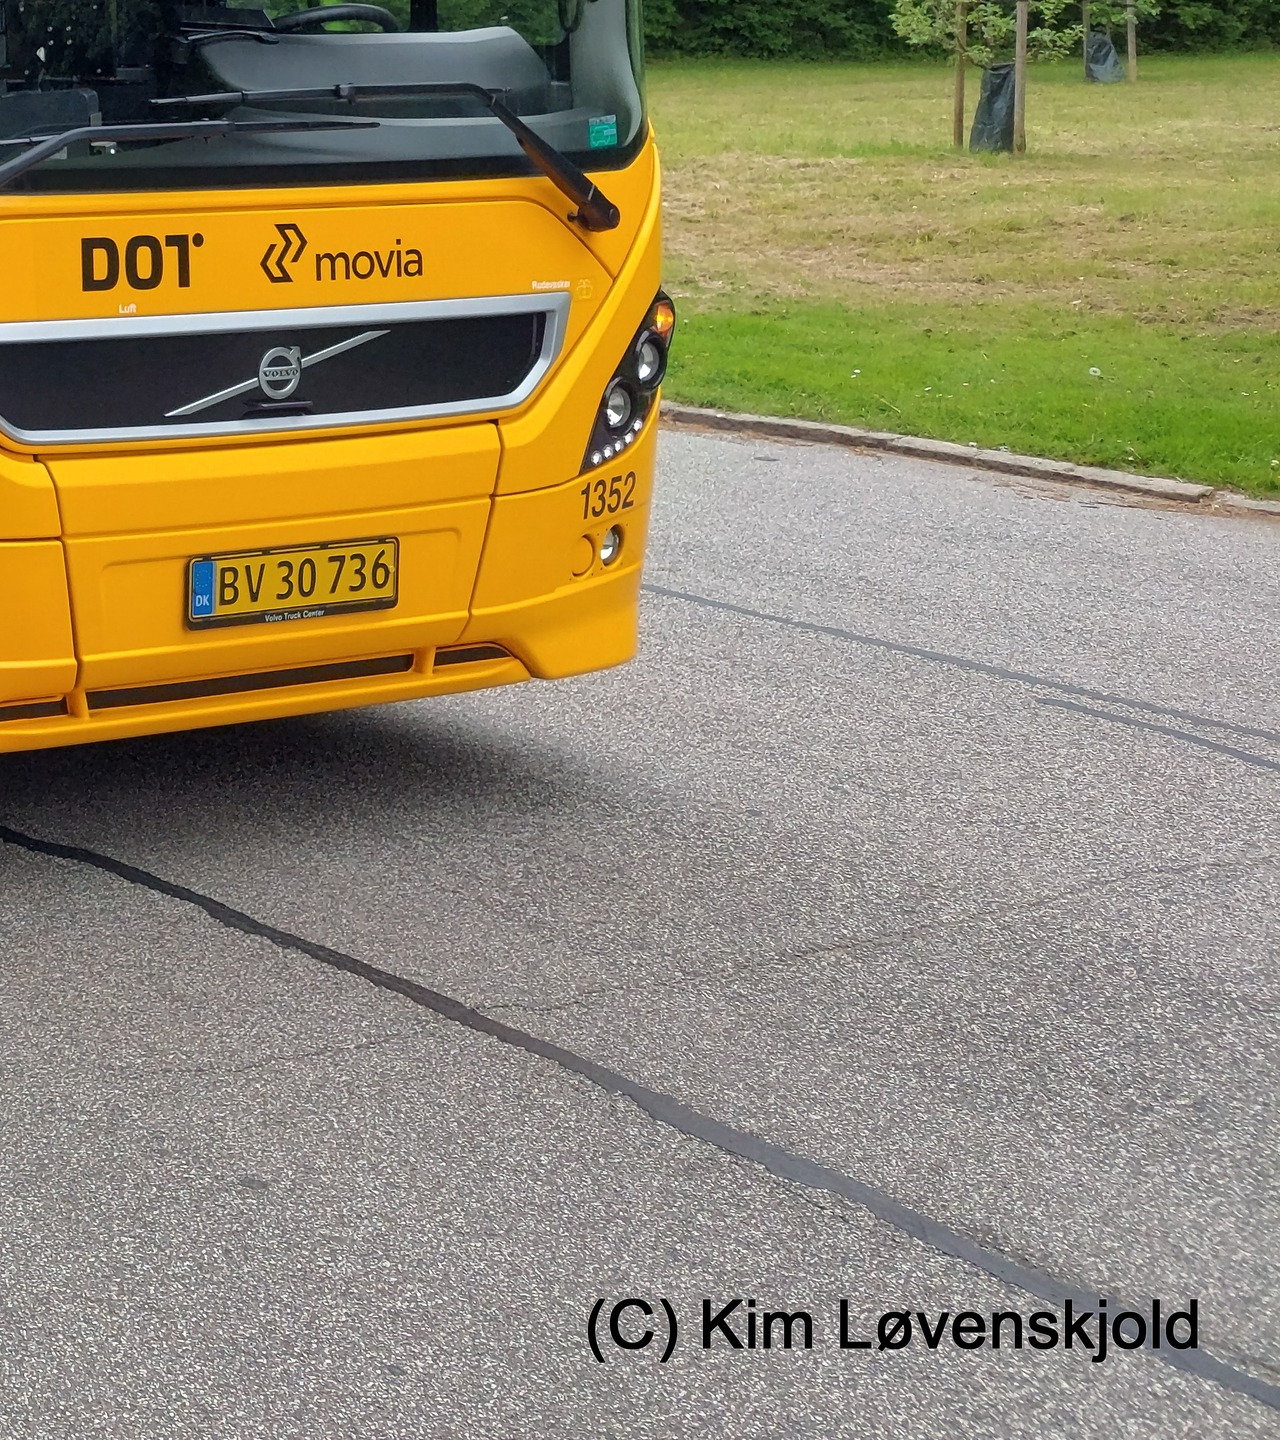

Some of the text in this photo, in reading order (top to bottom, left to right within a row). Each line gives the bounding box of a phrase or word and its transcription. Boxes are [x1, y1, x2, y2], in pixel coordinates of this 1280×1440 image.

[81, 232, 204, 292] DOT
[315, 238, 424, 282] movia
[262, 368, 299, 378] VOLVO
[580, 471, 637, 520] 1352
[218, 549, 391, 606] BV 30 736
[195, 594, 210, 607] DK
[264, 609, 325, 622] Volvo Truck Center
